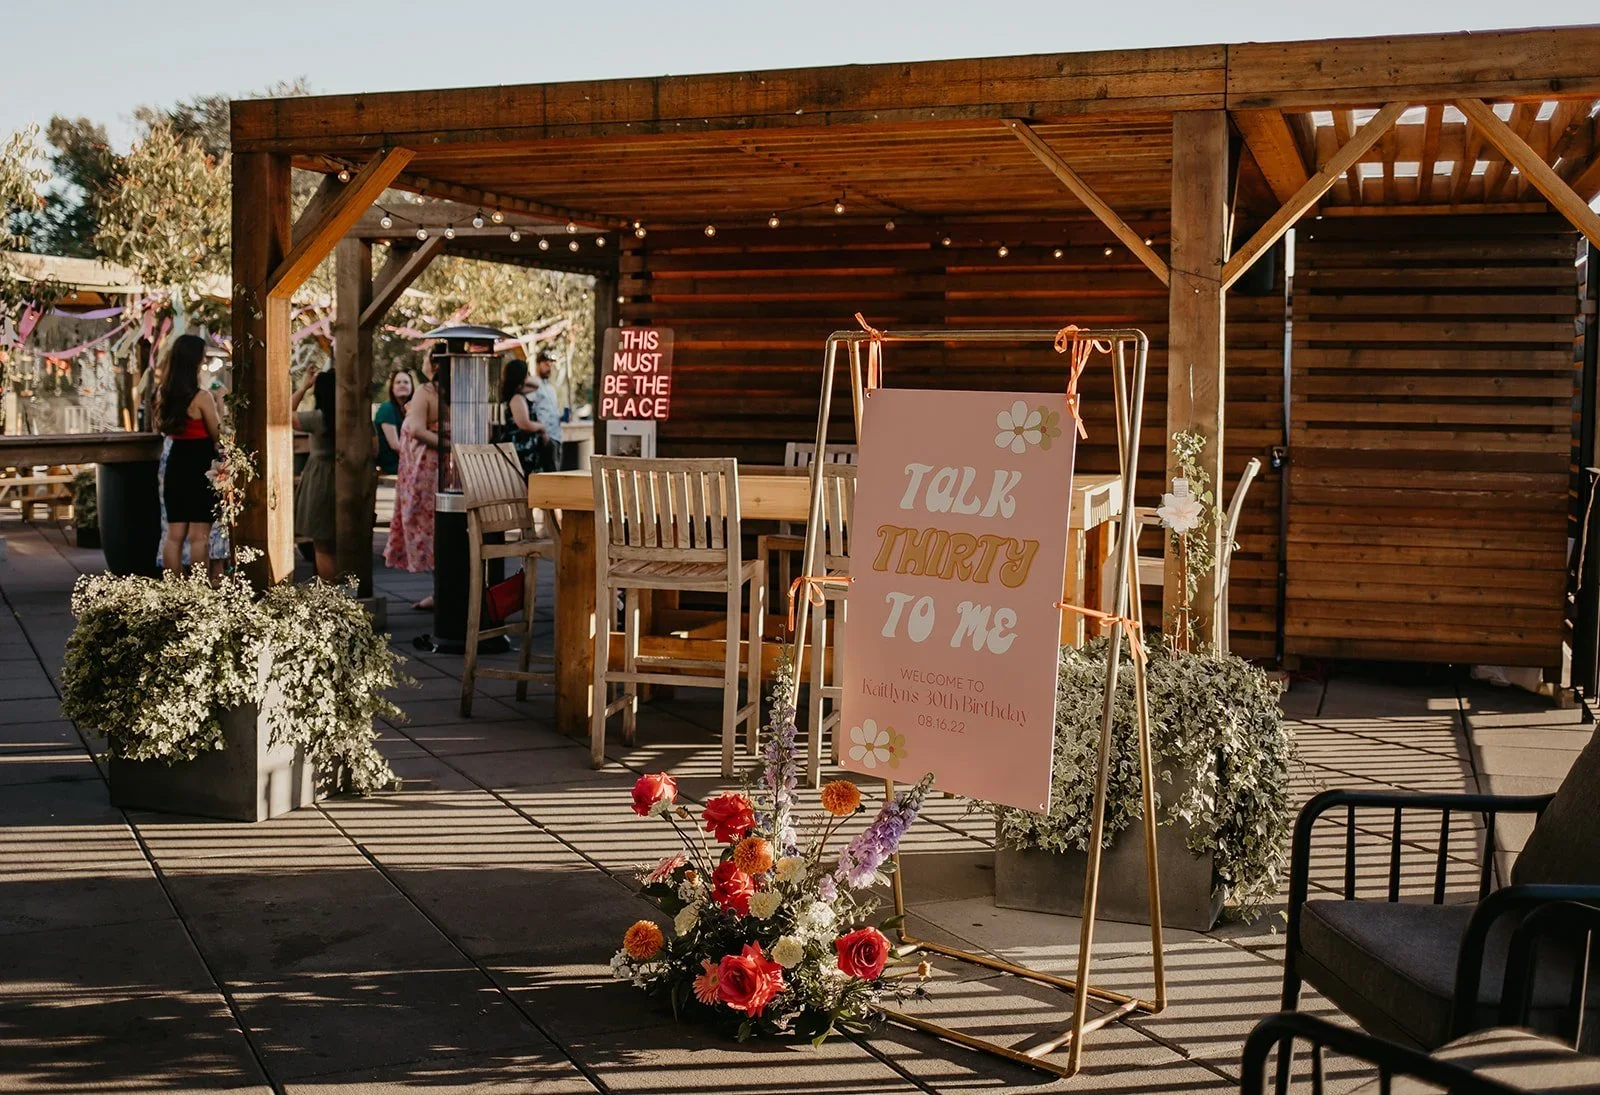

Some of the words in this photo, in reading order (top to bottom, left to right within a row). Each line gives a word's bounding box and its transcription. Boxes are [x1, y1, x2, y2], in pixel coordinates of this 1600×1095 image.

[620, 330, 658, 350] THIS
[613, 352, 662, 372] MUST
[604, 374, 628, 394] BE
[632, 375, 669, 395] THE
[602, 398, 668, 418] PLACE
[900, 463, 1022, 519] TALK
[872, 524, 1040, 588] THIRTY
[881, 591, 935, 643] TO
[950, 601, 1018, 655] ME
[900, 668, 964, 690] WELCOME
[967, 679, 985, 693] TO
[925, 689, 959, 712] 30th
[962, 695, 1030, 727] Birthday
[917, 714, 966, 734] 08.16.22
